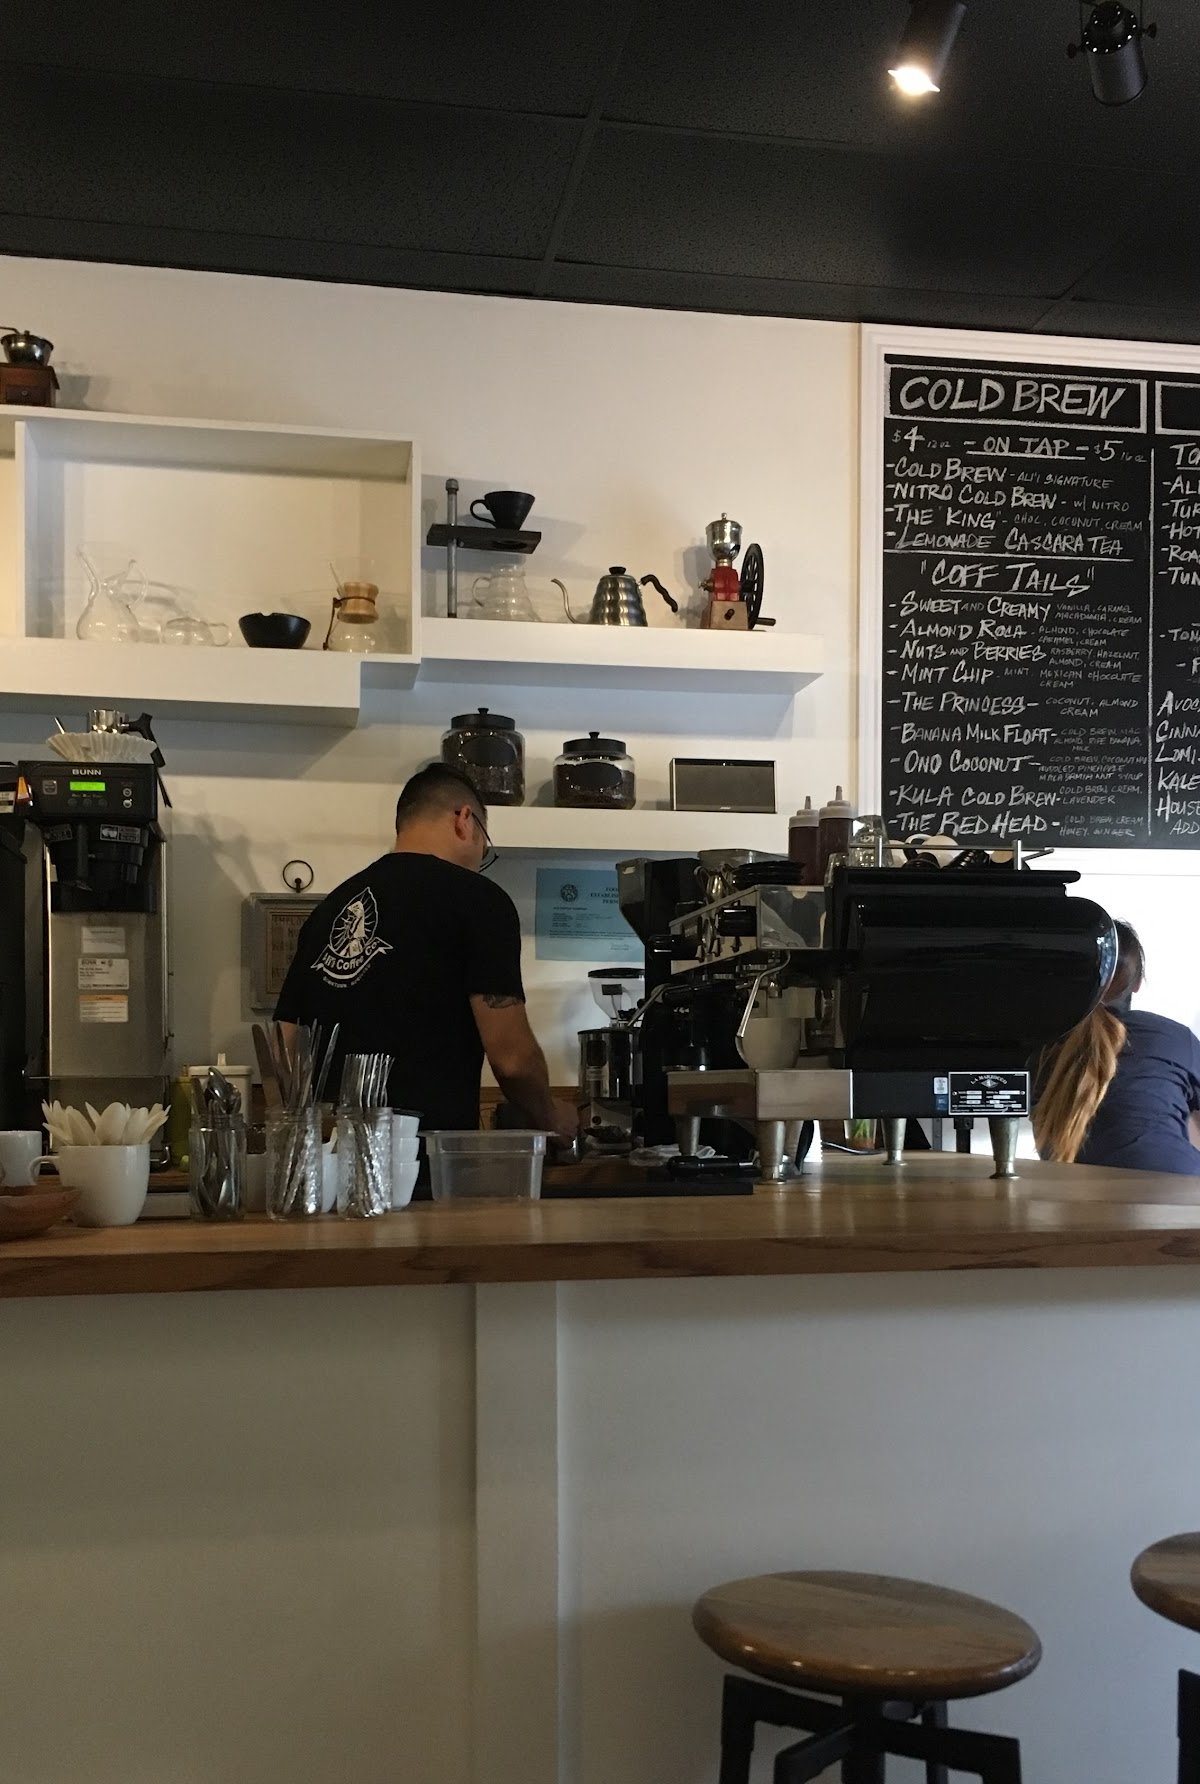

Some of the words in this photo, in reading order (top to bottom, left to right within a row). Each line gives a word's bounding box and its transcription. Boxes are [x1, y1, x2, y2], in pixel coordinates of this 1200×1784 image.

[899, 376, 1006, 413] COLD
[1012, 379, 1127, 419] BREW
[983, 436, 1011, 454] ON
[1018, 437, 1070, 458] TAP
[895, 456, 942, 479] COLD
[944, 458, 1007, 483] BREW
[1043, 473, 1114, 490] SIGNATURE
[893, 482, 953, 501] NITRO
[958, 483, 1007, 507] COLD
[1010, 485, 1058, 510] BREW
[1091, 501, 1130, 512] NITRO
[894, 503, 934, 526] THE
[1105, 520, 1143, 532] CREAM
[895, 521, 997, 550] LEMONADE
[1004, 527, 1085, 554] CASCARA
[1088, 535, 1124, 556] TEA
[1168, 544, 1200, 564] ROA
[899, 590, 962, 618] SWEET
[987, 596, 1052, 624] CREAMY
[899, 618, 974, 641] ALMOND
[976, 619, 1027, 640] ROCA
[900, 638, 948, 661] NUTS
[949, 647, 969, 657] AND
[971, 641, 1048, 662] BERRIES
[1079, 639, 1107, 647] CREAM
[901, 662, 950, 685] MINT
[952, 659, 995, 685] CHIP
[1040, 668, 1083, 681] MEXICAN
[1089, 661, 1122, 670] CREAM
[1040, 680, 1074, 690] CREAM
[902, 691, 935, 713] THE
[938, 691, 1026, 716] PRINCESS
[1099, 698, 1139, 709] ALMOND
[1060, 706, 1099, 718] CREAM
[1156, 690, 1200, 717] AVOC
[901, 722, 962, 744] BANANA
[965, 722, 1001, 744] MILK
[1003, 723, 1053, 746] FLOAT
[1155, 719, 1200, 744] CINN
[72, 768, 102, 776] BUNN
[904, 749, 943, 775] ONO
[950, 748, 1035, 774] COCONUT
[1157, 766, 1200, 793] KALE
[896, 784, 955, 807] KULA
[961, 787, 1006, 807] COLD
[1008, 785, 1057, 808] BREW
[1062, 795, 1116, 805] LAVENDER
[896, 811, 937, 832] THE
[937, 811, 990, 837] RED
[989, 810, 1048, 839] HEAD
